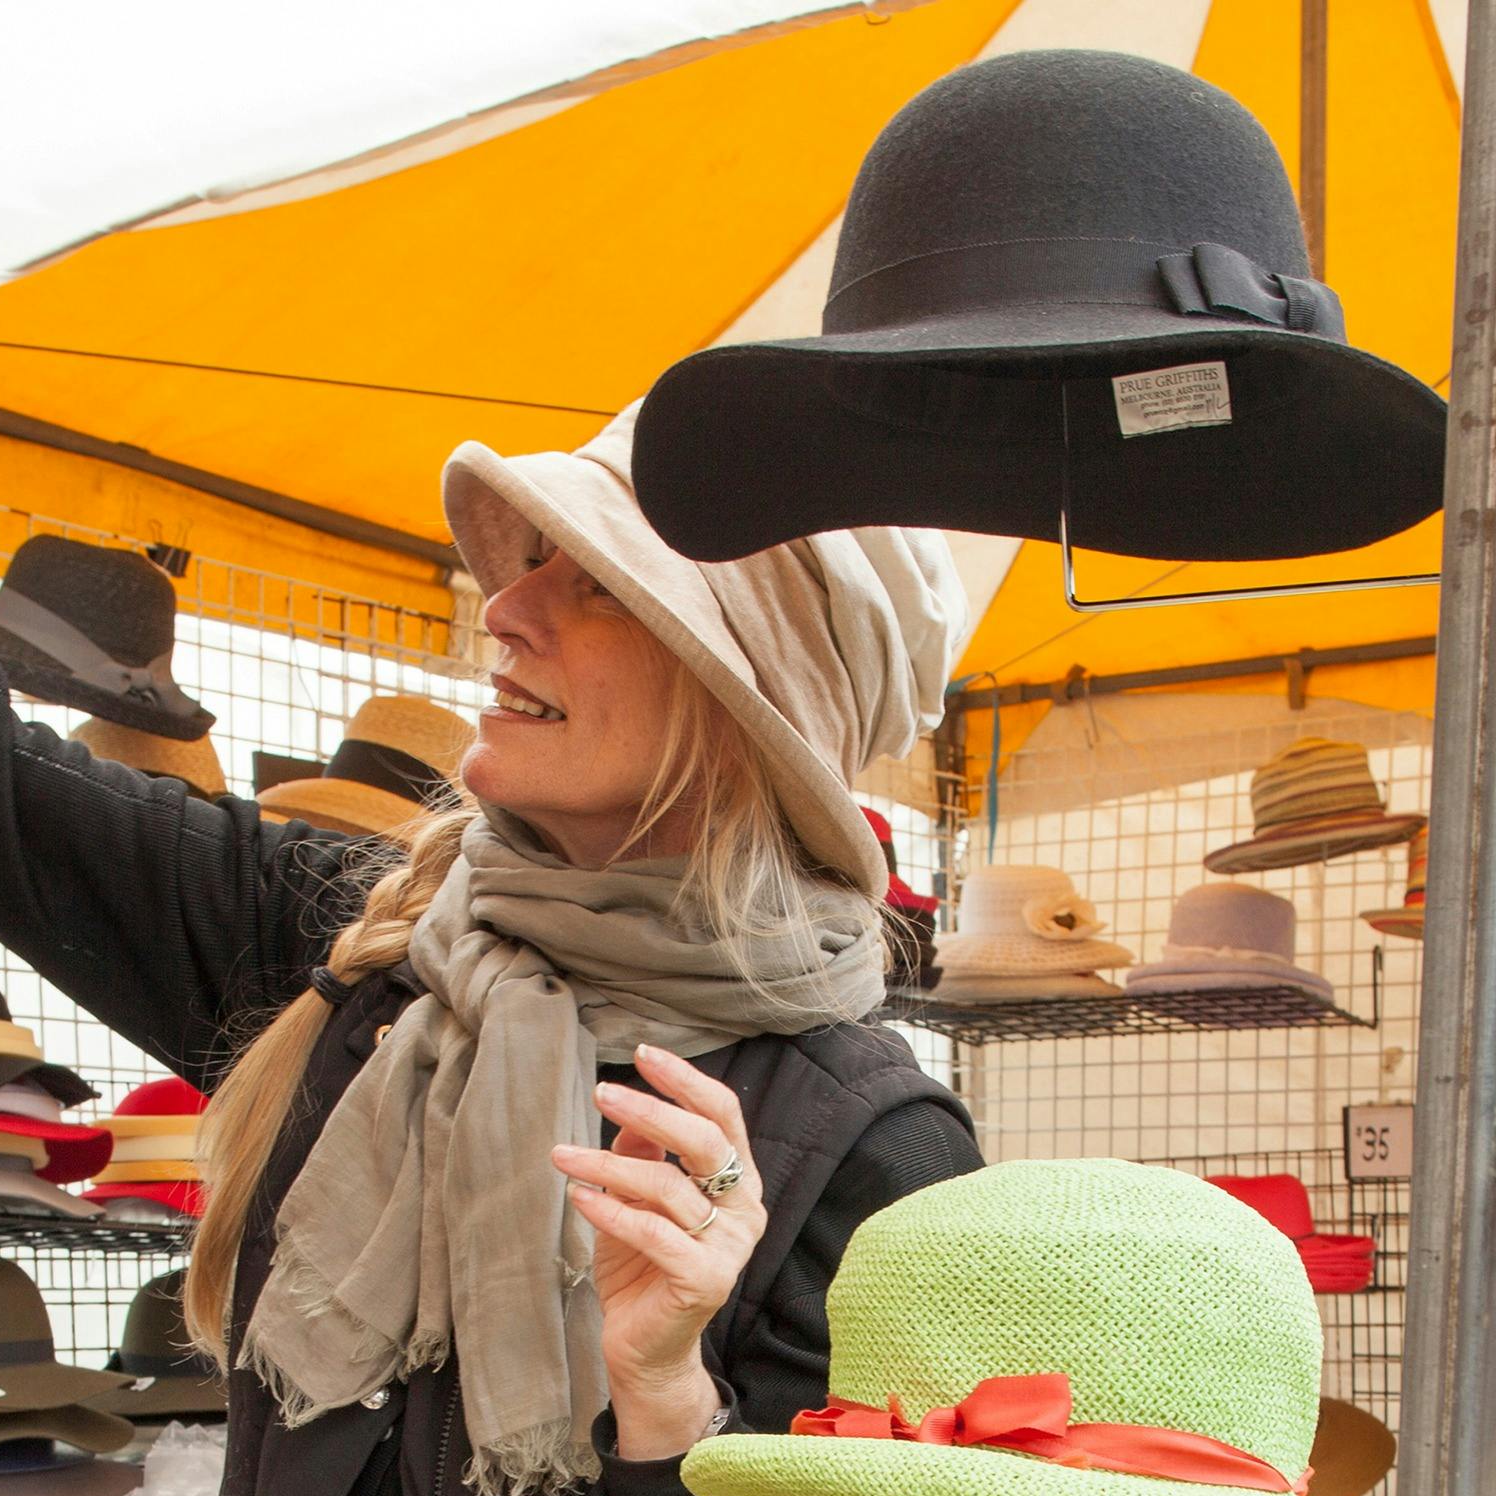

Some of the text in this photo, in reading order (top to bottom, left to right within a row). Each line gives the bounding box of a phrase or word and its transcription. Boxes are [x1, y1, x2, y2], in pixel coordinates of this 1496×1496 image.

[1120, 368, 1219, 393] PRUE GRIFFITHS
[1176, 383, 1221, 396] AUSTRALIA
